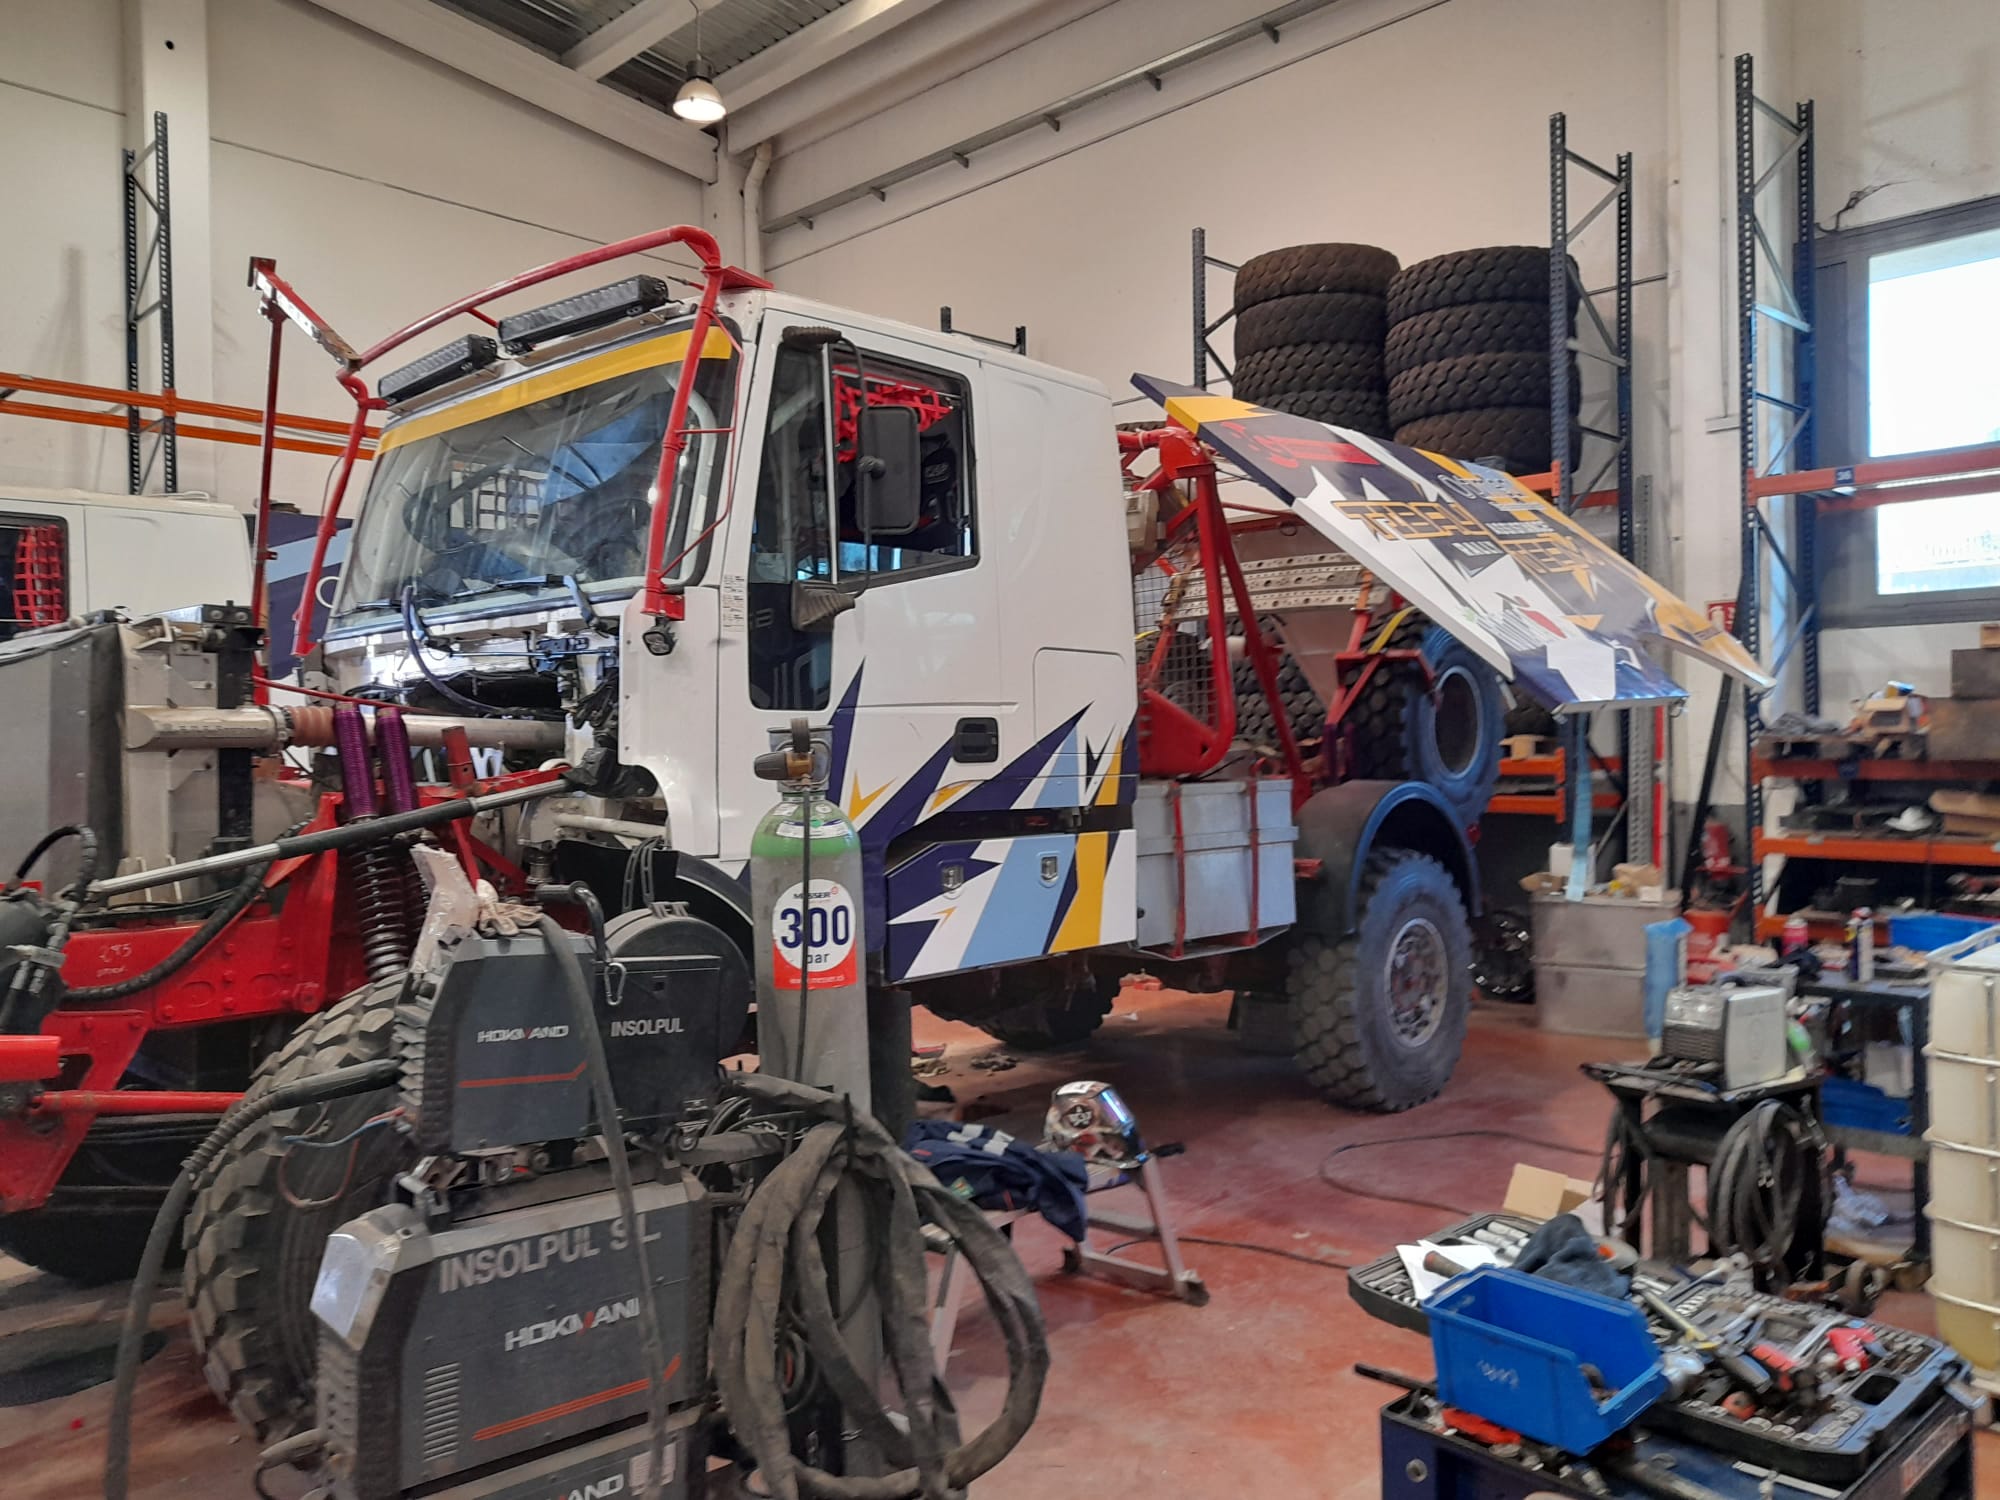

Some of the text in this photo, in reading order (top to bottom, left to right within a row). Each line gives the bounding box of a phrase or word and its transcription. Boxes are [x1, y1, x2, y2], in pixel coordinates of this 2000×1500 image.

[780, 905, 849, 949] 300
[610, 1017, 685, 1037] INSOLPUL
[438, 1226, 601, 1294] INSOLPUL
